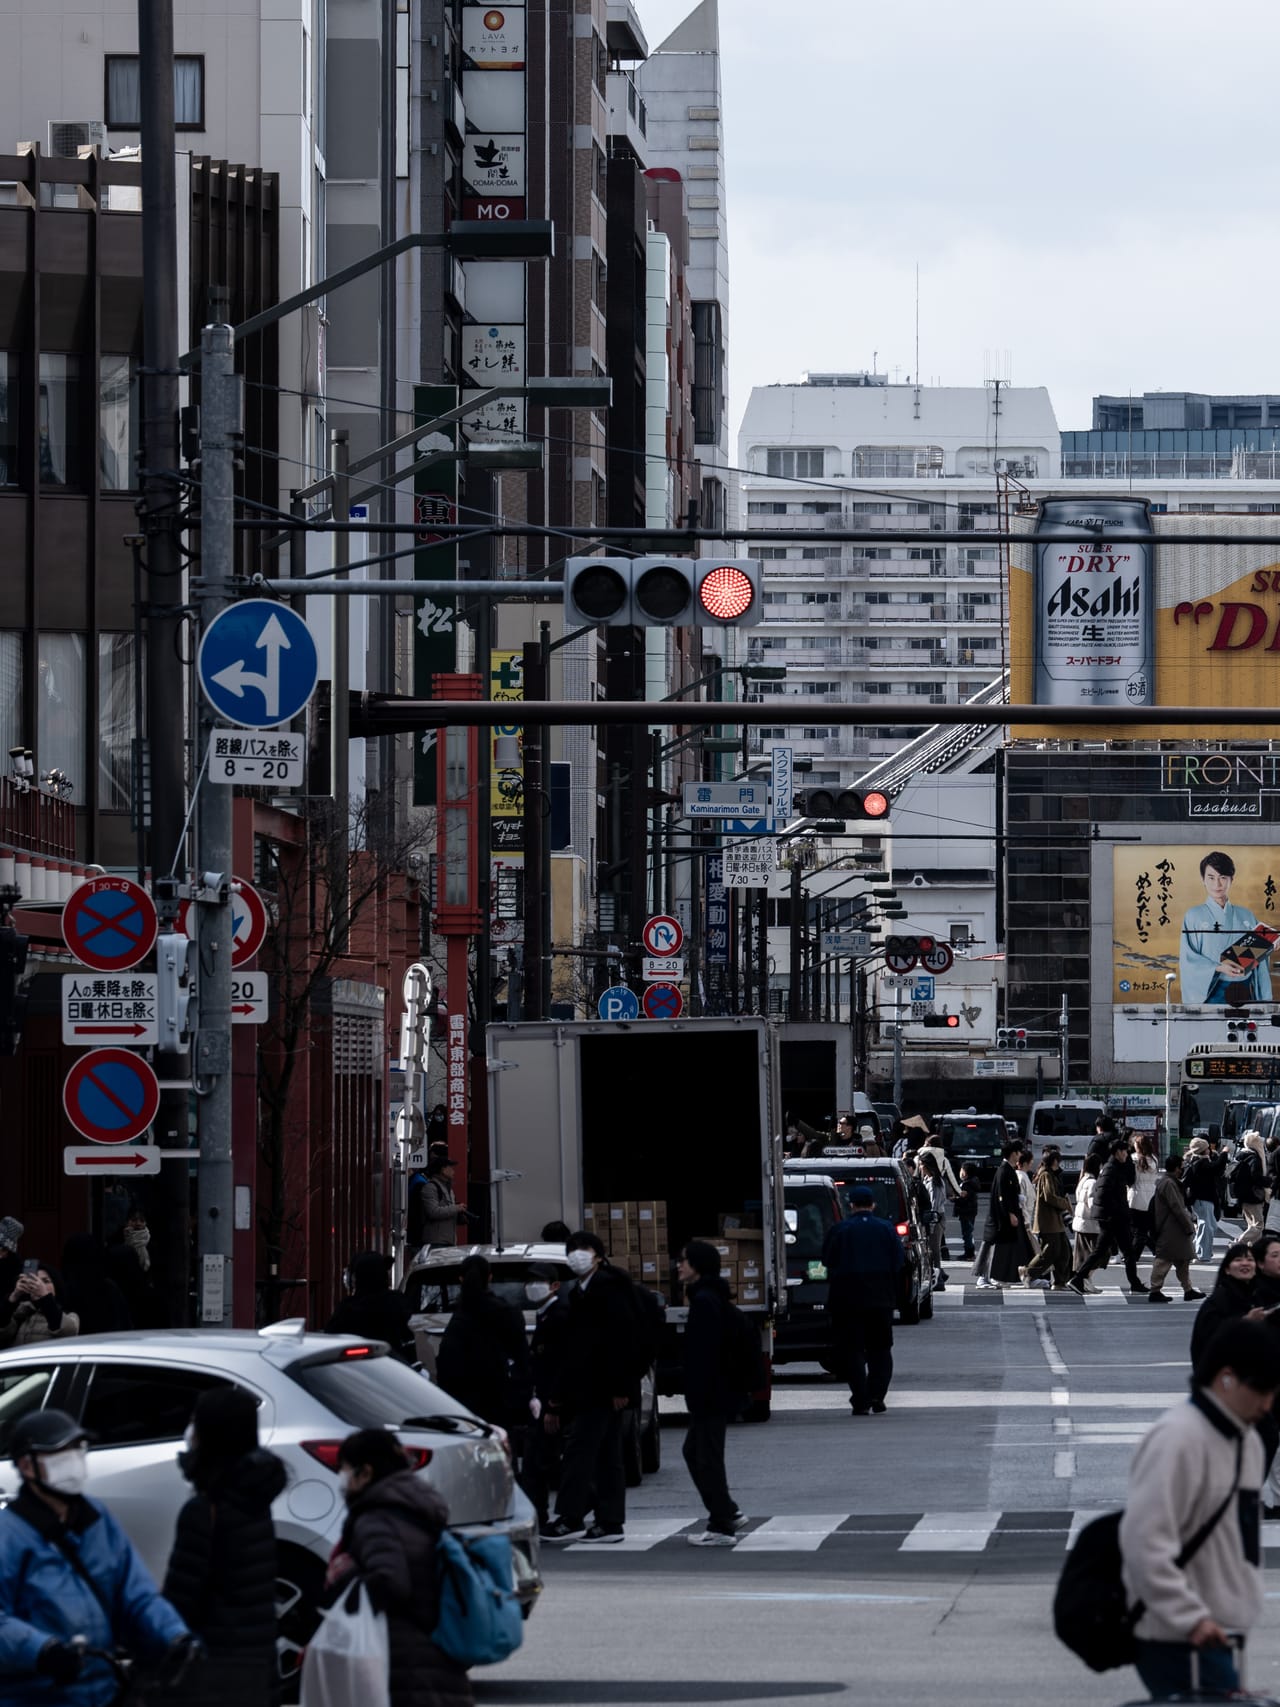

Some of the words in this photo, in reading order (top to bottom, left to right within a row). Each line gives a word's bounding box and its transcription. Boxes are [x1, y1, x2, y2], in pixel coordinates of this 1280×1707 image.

[468, 45, 519, 54] ホットヨガ
[472, 179, 518, 187] DOMA-DOMA
[477, 204, 510, 219] MO
[1077, 544, 1113, 553] SUER
[1047, 575, 1140, 617] Asahi
[1082, 624, 1105, 642] 生
[1066, 655, 1121, 666] スーパードライ
[1127, 681, 1146, 697] お酒
[215, 737, 298, 758] 路線バスを除く
[776, 750, 789, 816] スクランブル式
[690, 804, 739, 814] Kaminarimon
[742, 805, 760, 815] Gate
[1192, 798, 1258, 813] asakusa
[1155, 858, 1176, 926] かねふくの
[1263, 874, 1277, 911] あり
[1135, 871, 1152, 943] めんたいこ
[69, 979, 154, 998] 人の乗降を除く
[1132, 980, 1166, 991] かねふく
[607, 999, 623, 1020] P
[449, 1014, 465, 1126] 雷門東部商店会
